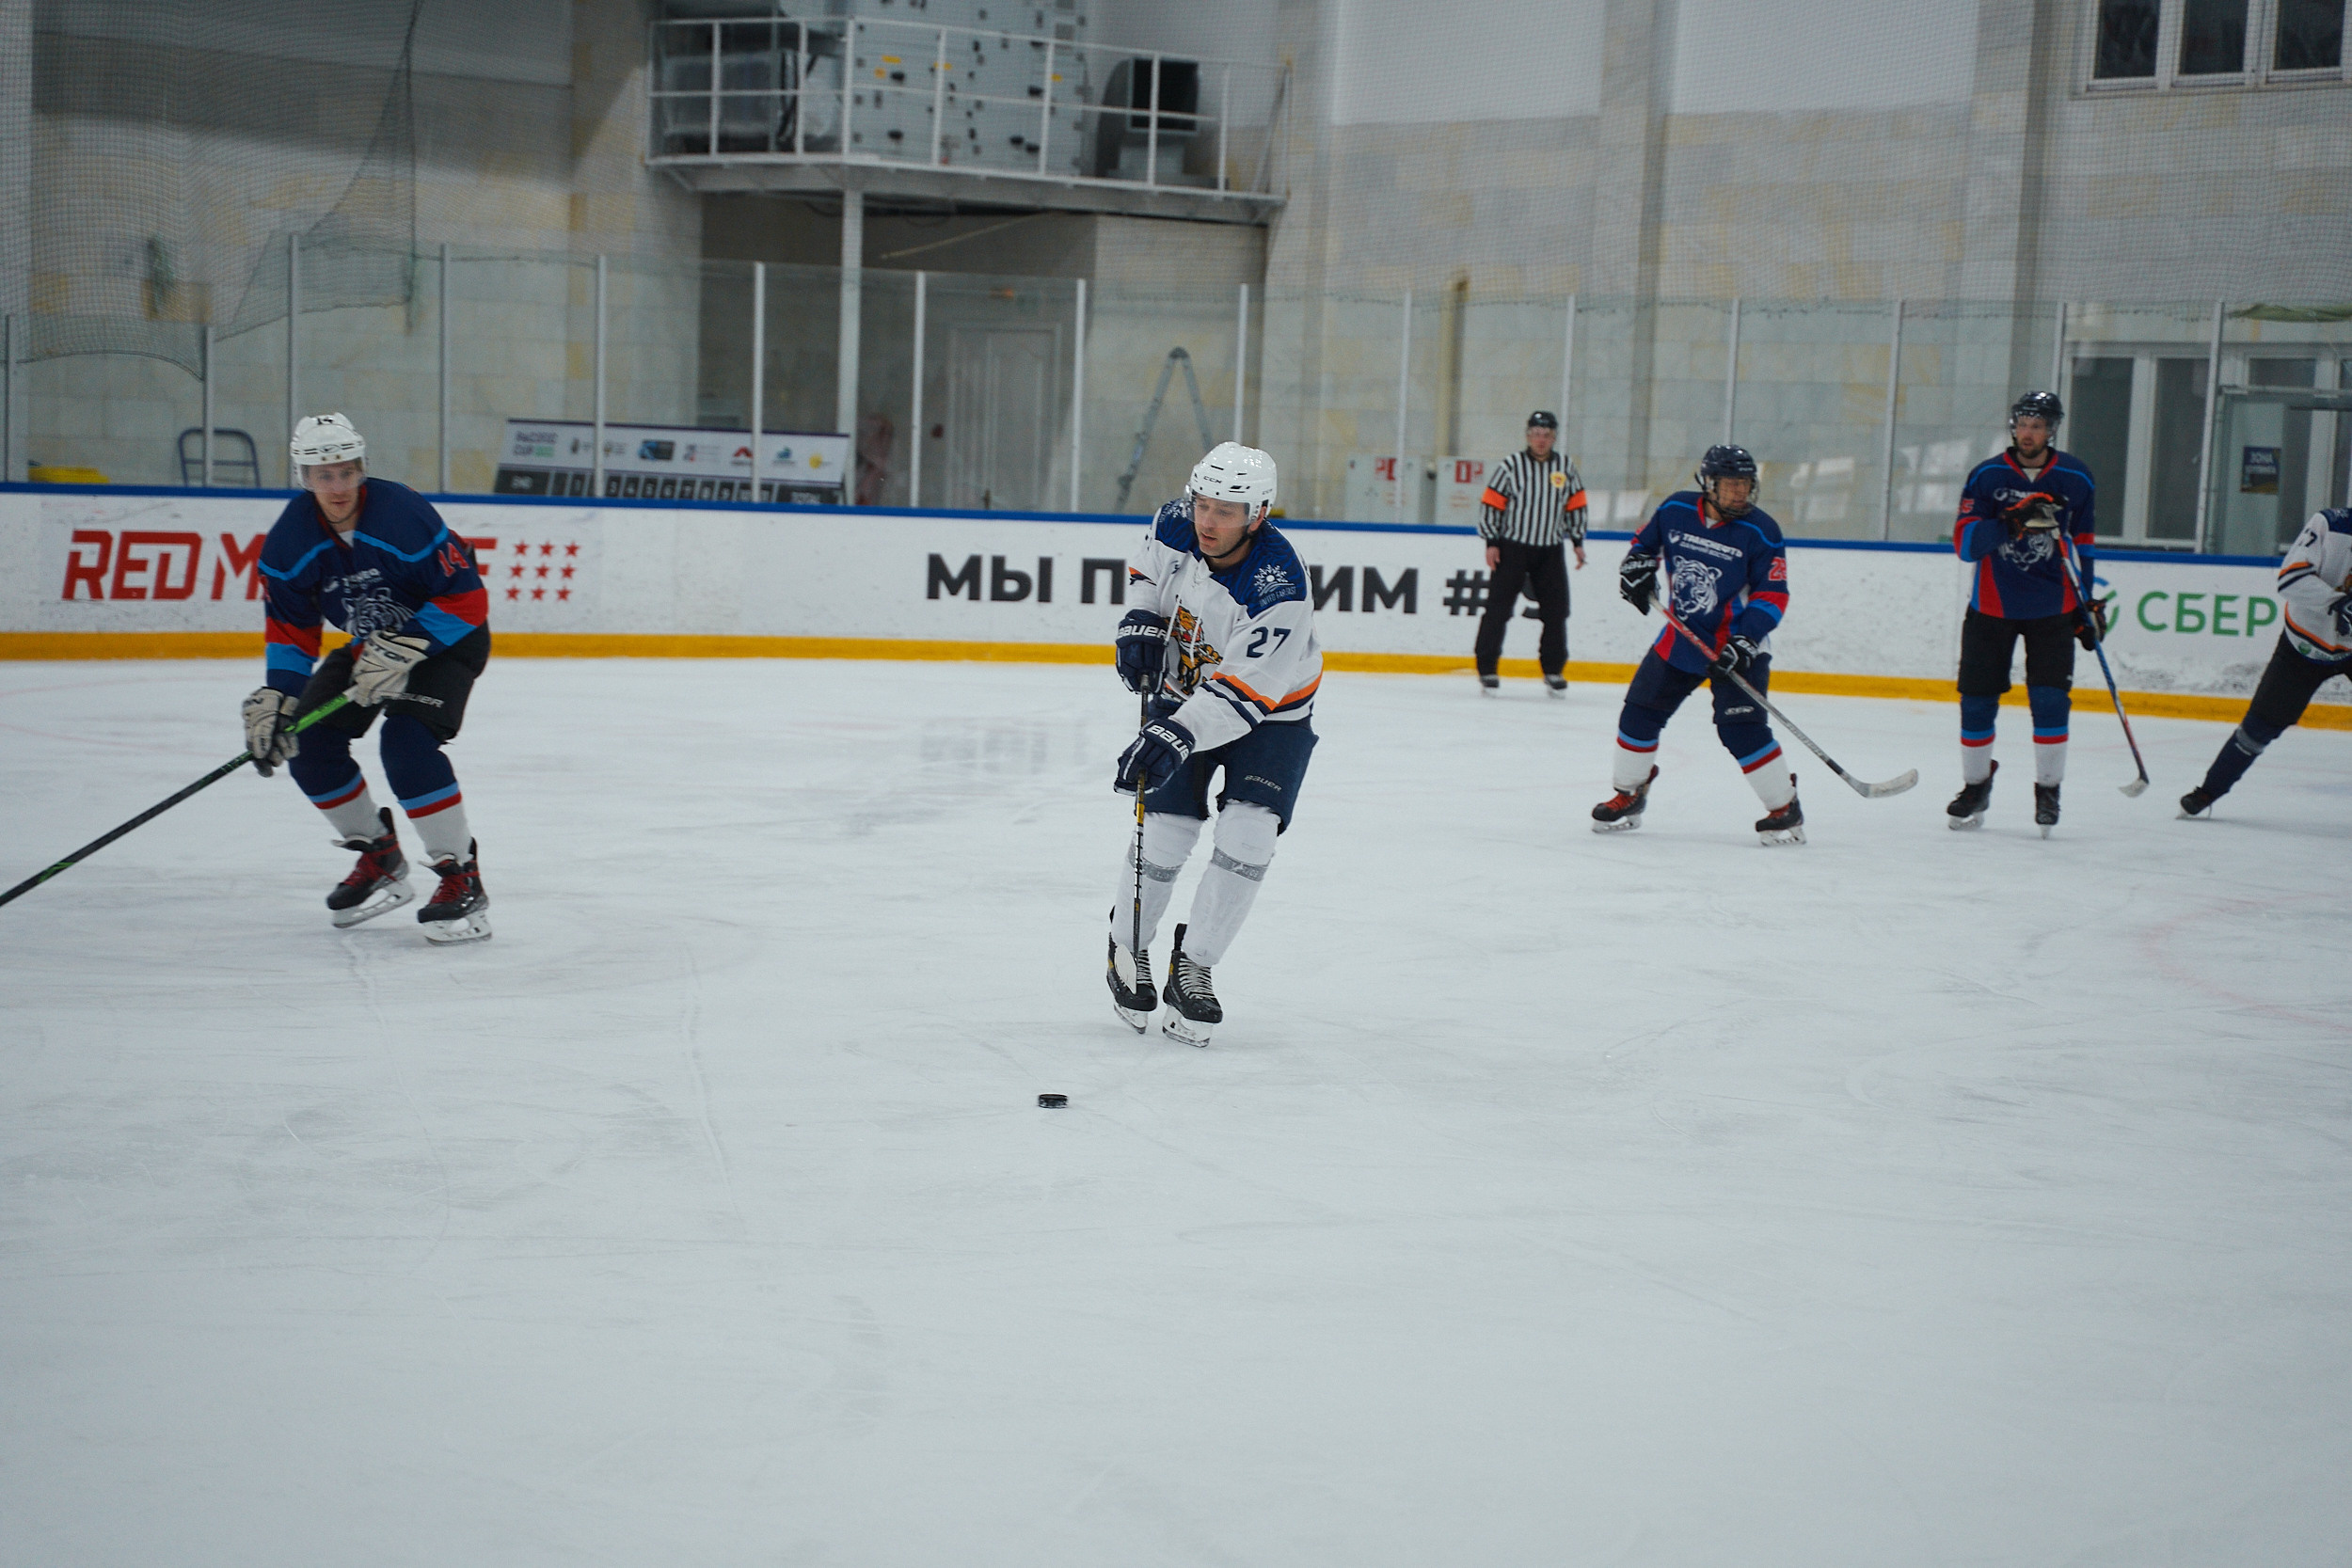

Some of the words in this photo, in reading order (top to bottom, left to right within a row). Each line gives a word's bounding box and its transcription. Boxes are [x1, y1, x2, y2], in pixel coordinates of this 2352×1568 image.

[1203, 475, 1222, 483] CCM
[1957, 499, 1975, 515] 5
[63, 530, 202, 600] RED
[437, 542, 469, 578] 14
[926, 553, 1053, 603] МЫ
[2137, 591, 2279, 637] СБЕР
[1246, 626, 1291, 658] 27
[1147, 724, 1190, 765] BAUE
[1245, 774, 1282, 792] BAUER
